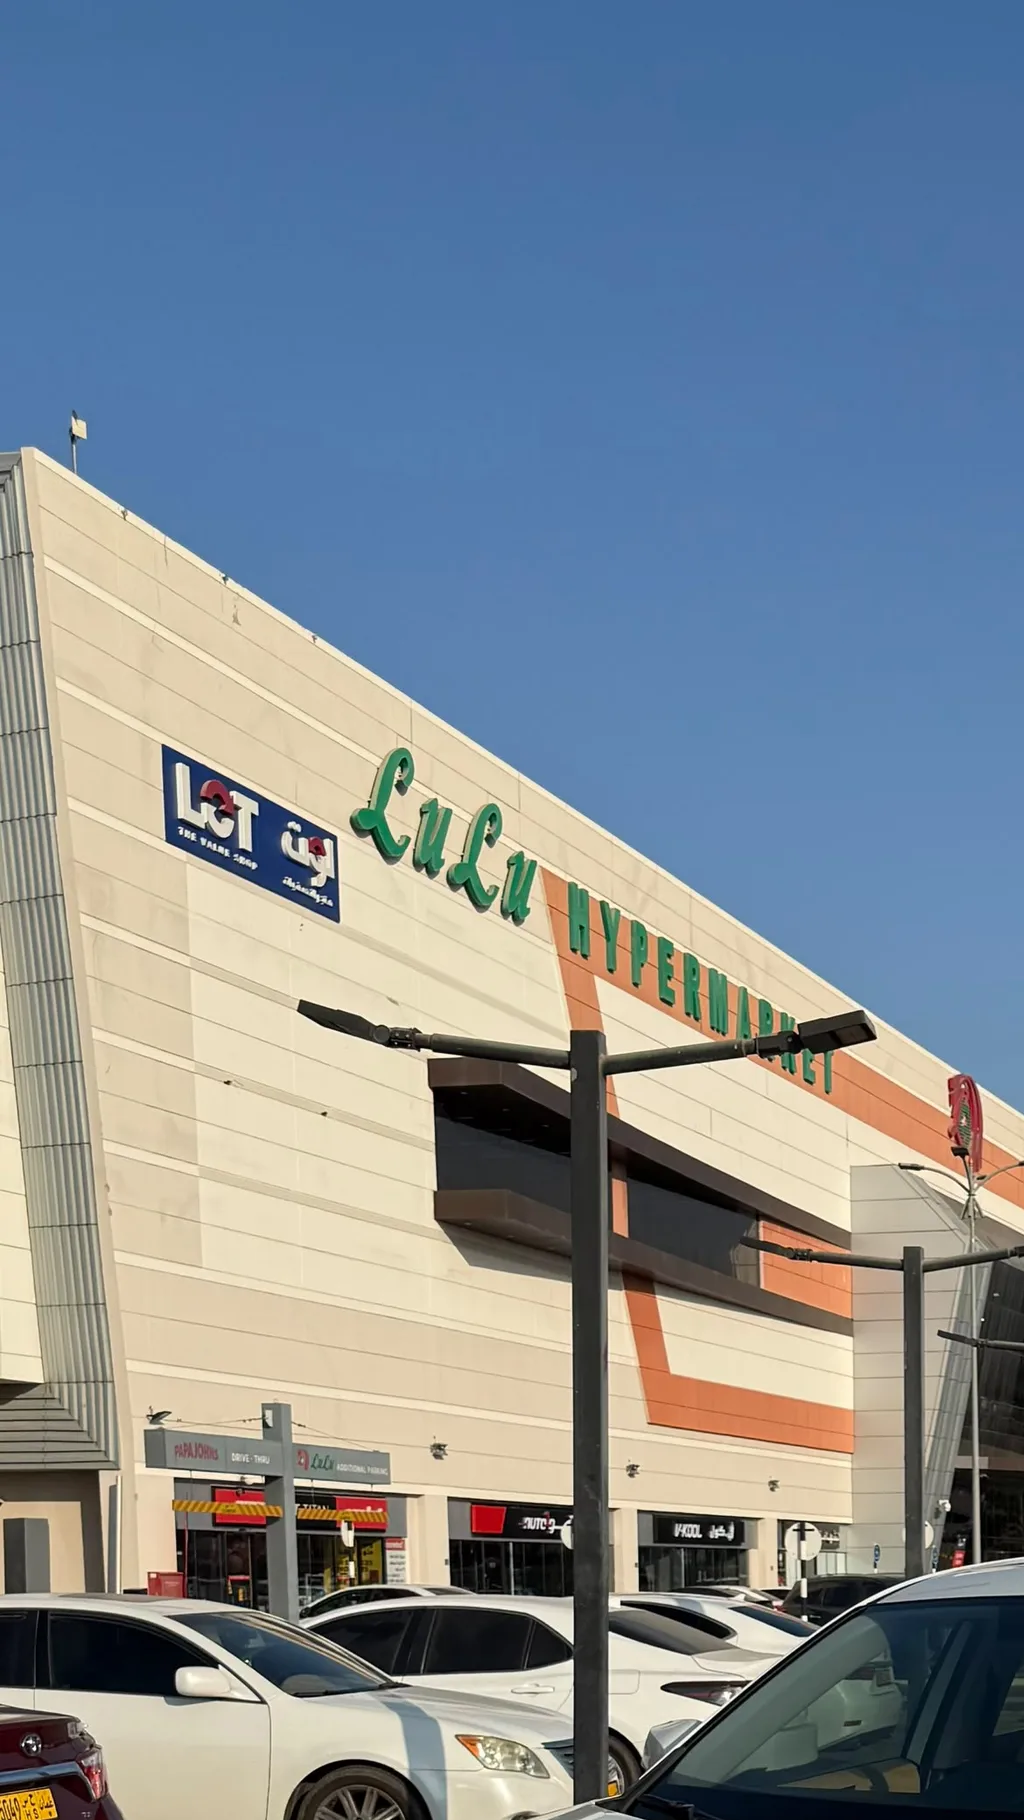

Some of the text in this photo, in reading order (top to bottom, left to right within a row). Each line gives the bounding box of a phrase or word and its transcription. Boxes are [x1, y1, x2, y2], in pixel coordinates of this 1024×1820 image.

[175, 762, 259, 852] LOT
[178, 826, 197, 842] THE
[200, 837, 231, 858] VALUE
[281, 821, 335, 887] لوت
